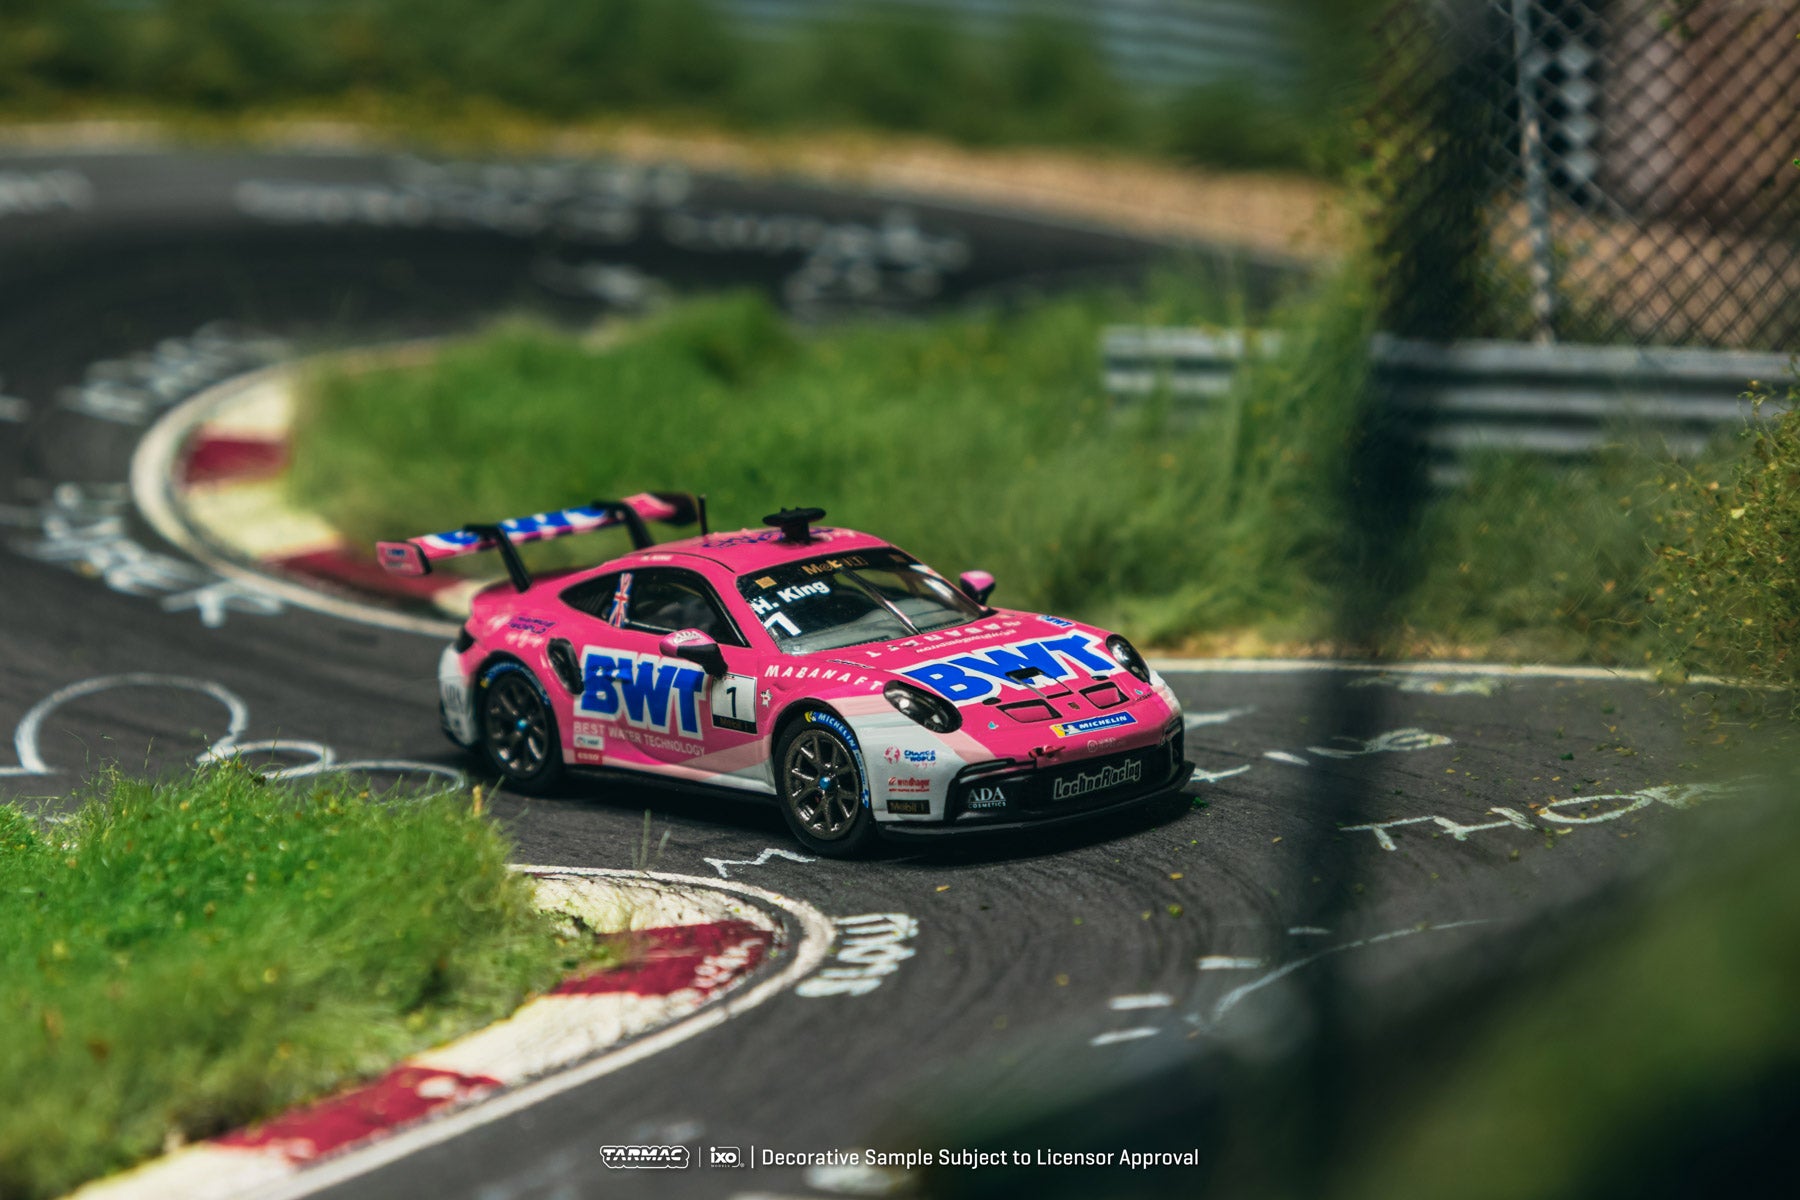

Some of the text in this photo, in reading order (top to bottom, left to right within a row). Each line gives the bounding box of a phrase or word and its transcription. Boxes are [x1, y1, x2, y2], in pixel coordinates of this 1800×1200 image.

[751, 581, 830, 615] H. King
[764, 665, 883, 691] MABANAFT
[898, 632, 1119, 703] BWT
[577, 649, 707, 737] BWT
[726, 686, 737, 718] 1
[573, 722, 705, 756] BEST WATER TECHNOLOGY
[818, 712, 856, 748] MICHELIN
[1079, 715, 1128, 730] MICHELIN
[968, 787, 1007, 801] ADA
[968, 801, 1007, 809] COSMETICS
